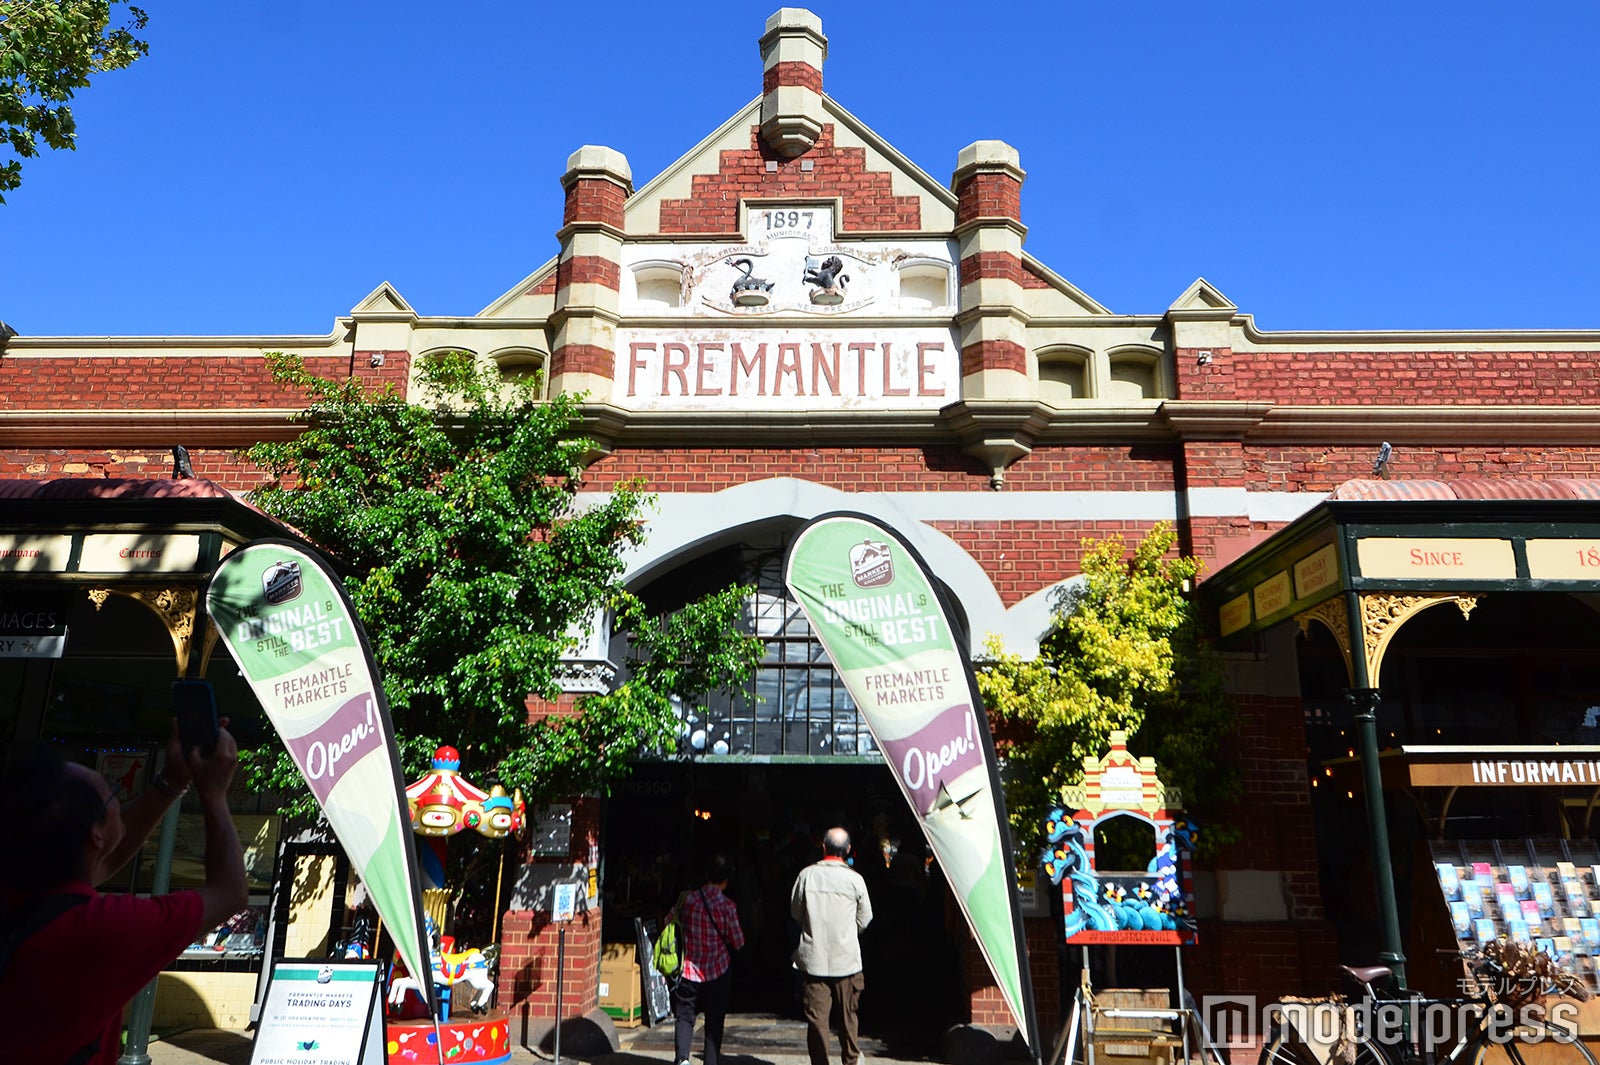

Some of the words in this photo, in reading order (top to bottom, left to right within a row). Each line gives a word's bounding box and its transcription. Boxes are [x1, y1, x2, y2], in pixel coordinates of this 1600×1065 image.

[764, 211, 814, 230] 1897
[626, 342, 946, 397] FREMANTLE
[118, 548, 162, 559] Curries
[1410, 548, 1464, 566] SINCE
[820, 583, 847, 599] THE
[236, 604, 259, 619] THE
[822, 592, 922, 625] ORIGINAL
[237, 601, 328, 643] ORIGINAL
[844, 623, 879, 638] STILL
[881, 615, 939, 646] BEST
[257, 636, 288, 652] STILL
[290, 617, 344, 653] BEST
[863, 636, 880, 648] THE
[273, 646, 290, 658] THE
[273, 663, 353, 696] FREMANTLE
[865, 668, 951, 691] FREMANTLE
[284, 680, 348, 709] MARKETS
[877, 685, 945, 707] MARKETS
[306, 698, 375, 780] Open!
[903, 711, 975, 790] Open!
[1471, 760, 1600, 783] INFORMATI
[287, 999, 326, 1008] TRADING
[328, 1000, 352, 1008] DAYS
